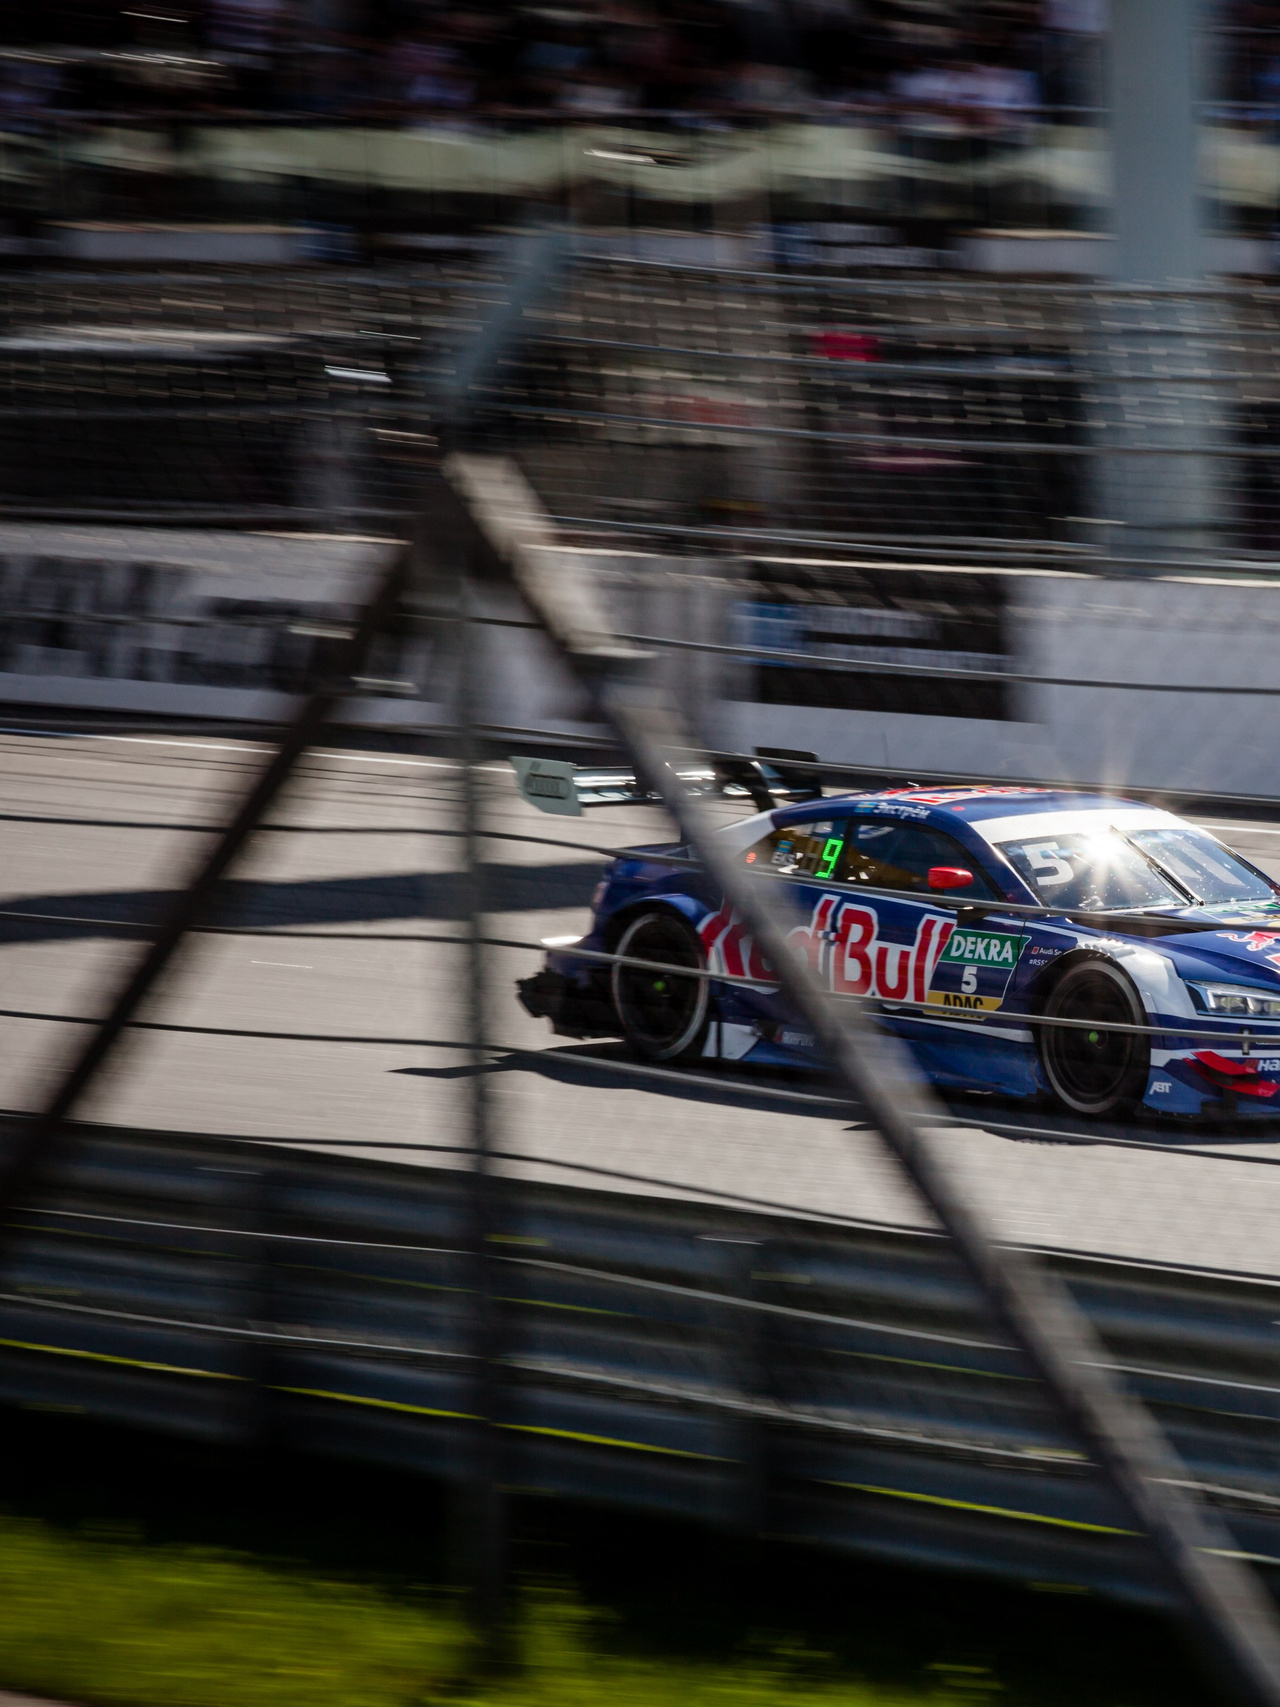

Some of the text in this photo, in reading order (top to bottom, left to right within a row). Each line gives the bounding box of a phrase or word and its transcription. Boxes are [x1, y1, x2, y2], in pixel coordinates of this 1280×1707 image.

[814, 838, 844, 878] 9
[1021, 841, 1075, 886] 5
[951, 935, 1013, 963] DEKRA
[1039, 947, 1054, 955] Audi
[961, 966, 978, 993] 5
[942, 994, 985, 1019] ADAC
[1149, 1082, 1172, 1095] ABT
